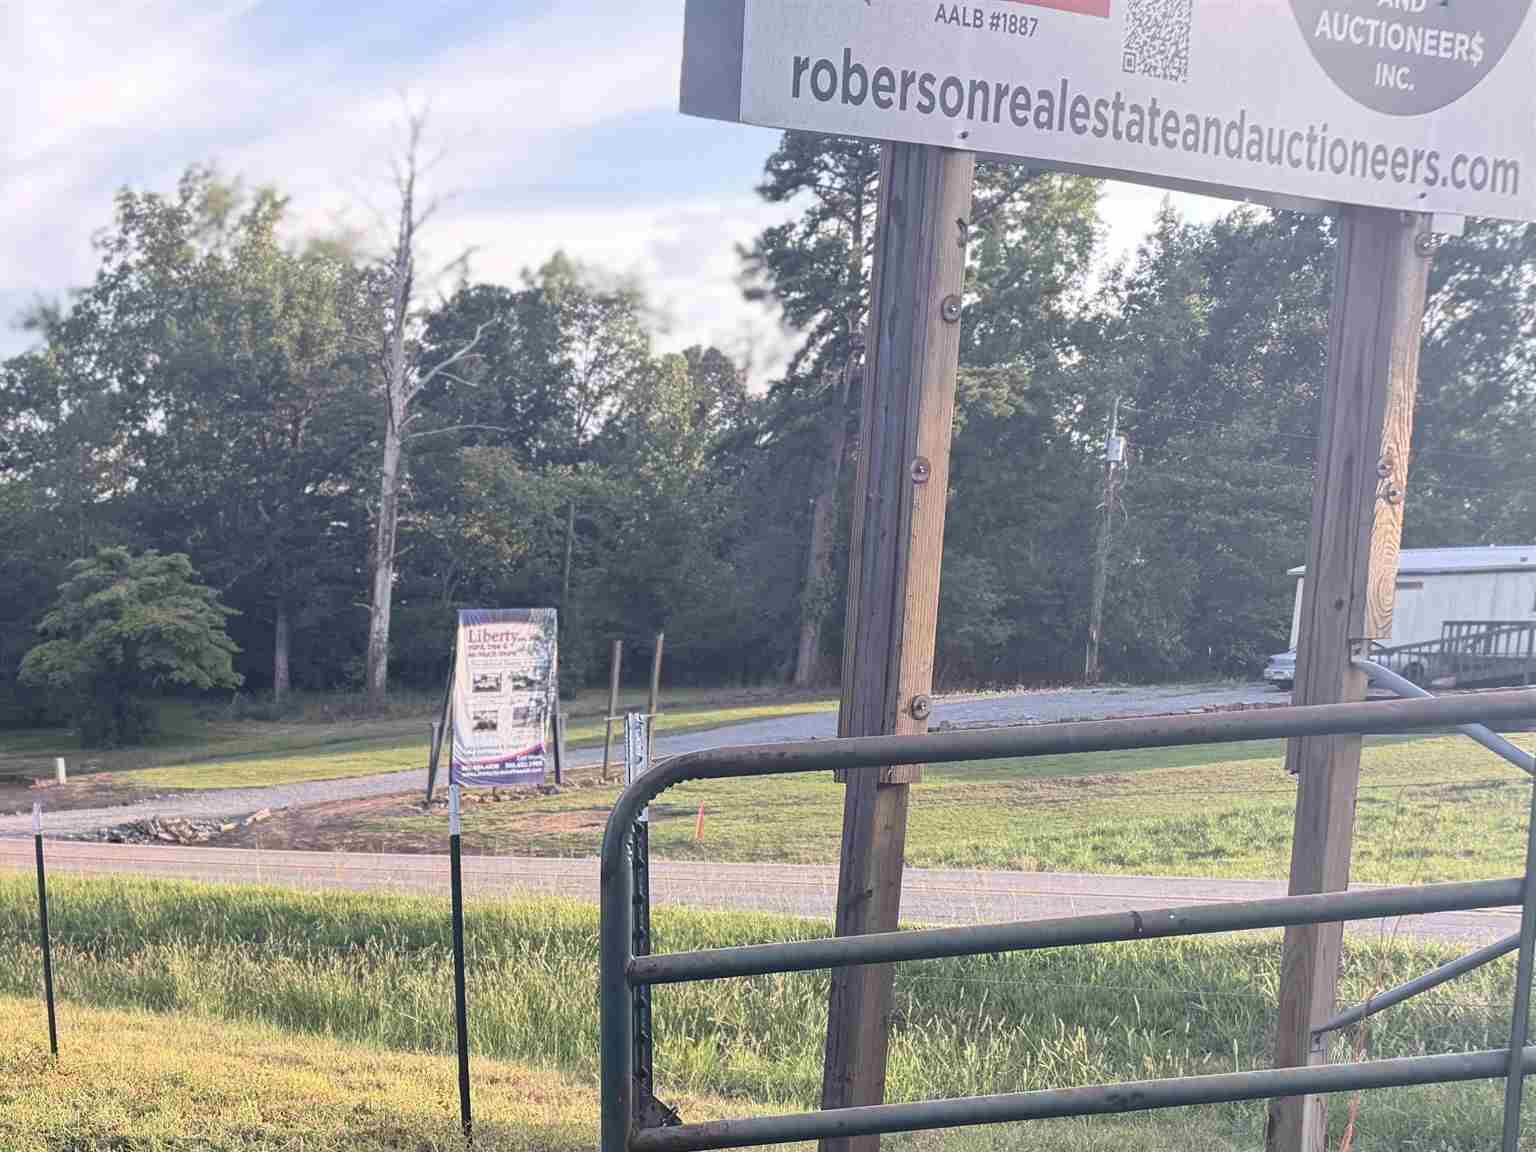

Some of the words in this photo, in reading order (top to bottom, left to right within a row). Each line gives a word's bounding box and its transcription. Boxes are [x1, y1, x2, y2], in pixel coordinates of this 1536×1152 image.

[934, 3, 984, 29] AALB
[989, 11, 1039, 37] #1887
[1374, 62, 1415, 91] INC.
[791, 48, 1520, 195] robersonrealestateandauctioneers.com
